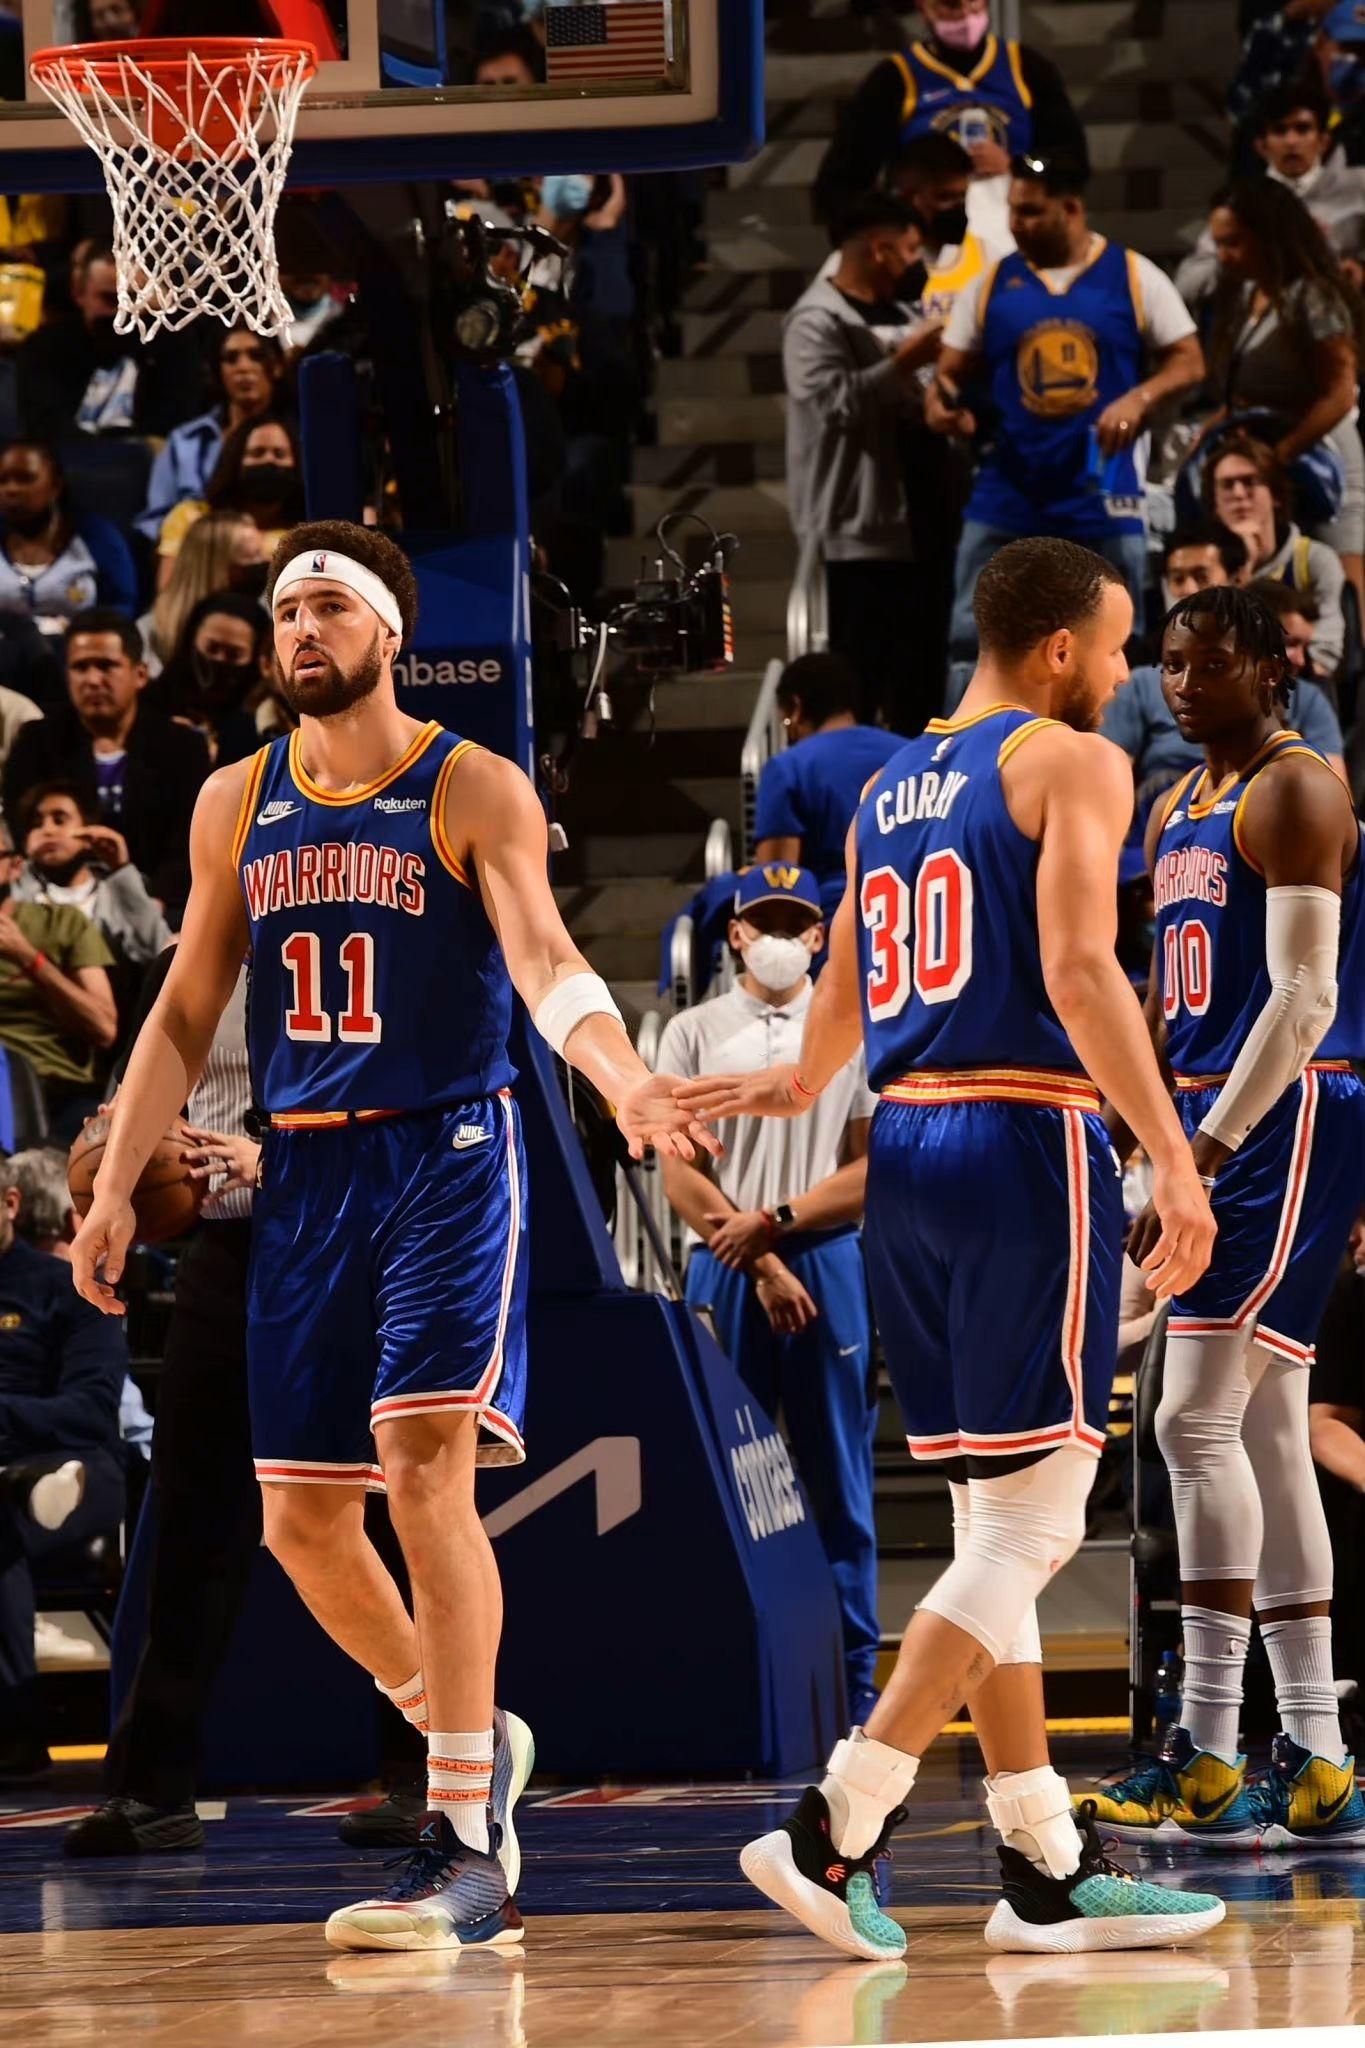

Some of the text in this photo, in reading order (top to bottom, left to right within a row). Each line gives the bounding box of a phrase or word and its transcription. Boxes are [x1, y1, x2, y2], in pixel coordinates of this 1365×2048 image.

[391, 654, 502, 687] nbase
[265, 801, 294, 816] NIKE
[374, 797, 427, 811] Rakuten
[876, 771, 970, 835] CURRY
[243, 842, 426, 922] WARRIORS
[762, 865, 801, 890] W
[860, 847, 974, 1023] 30
[281, 931, 382, 1043] 11
[1164, 919, 1211, 1020] 00
[459, 1123, 485, 1139] NIKE
